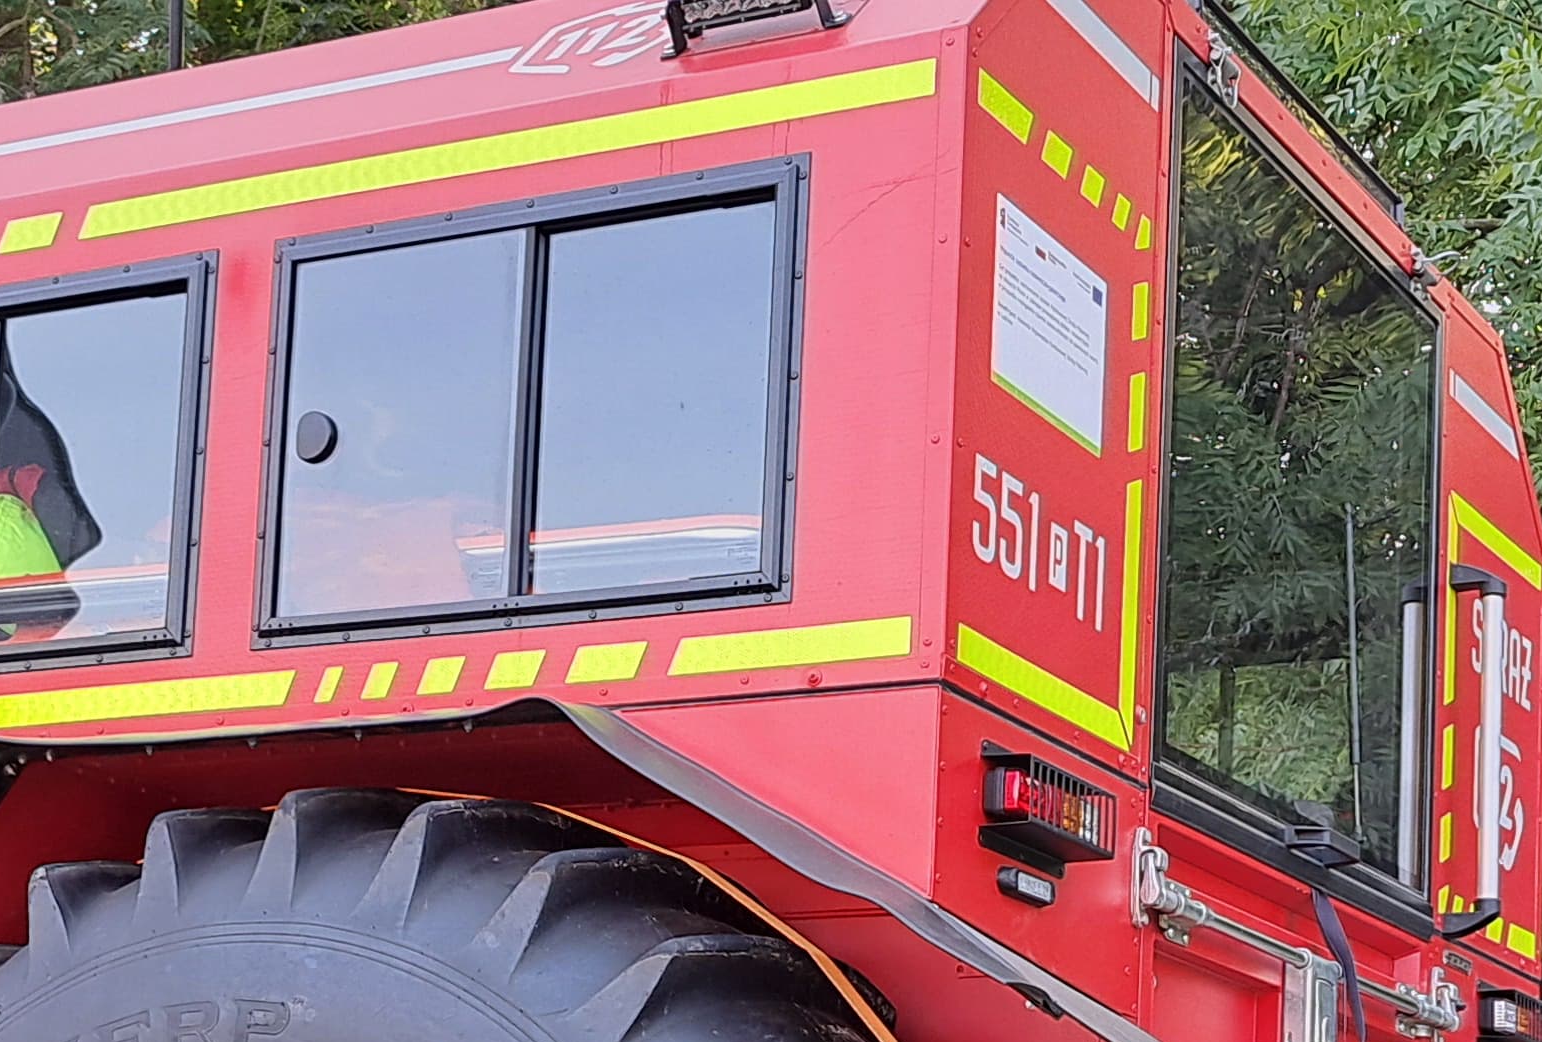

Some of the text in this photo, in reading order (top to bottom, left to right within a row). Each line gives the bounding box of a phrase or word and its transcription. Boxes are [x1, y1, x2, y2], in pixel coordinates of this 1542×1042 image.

[545, 13, 662, 62] 112
[971, 453, 1039, 593] 551
[1073, 519, 1107, 633] T1
